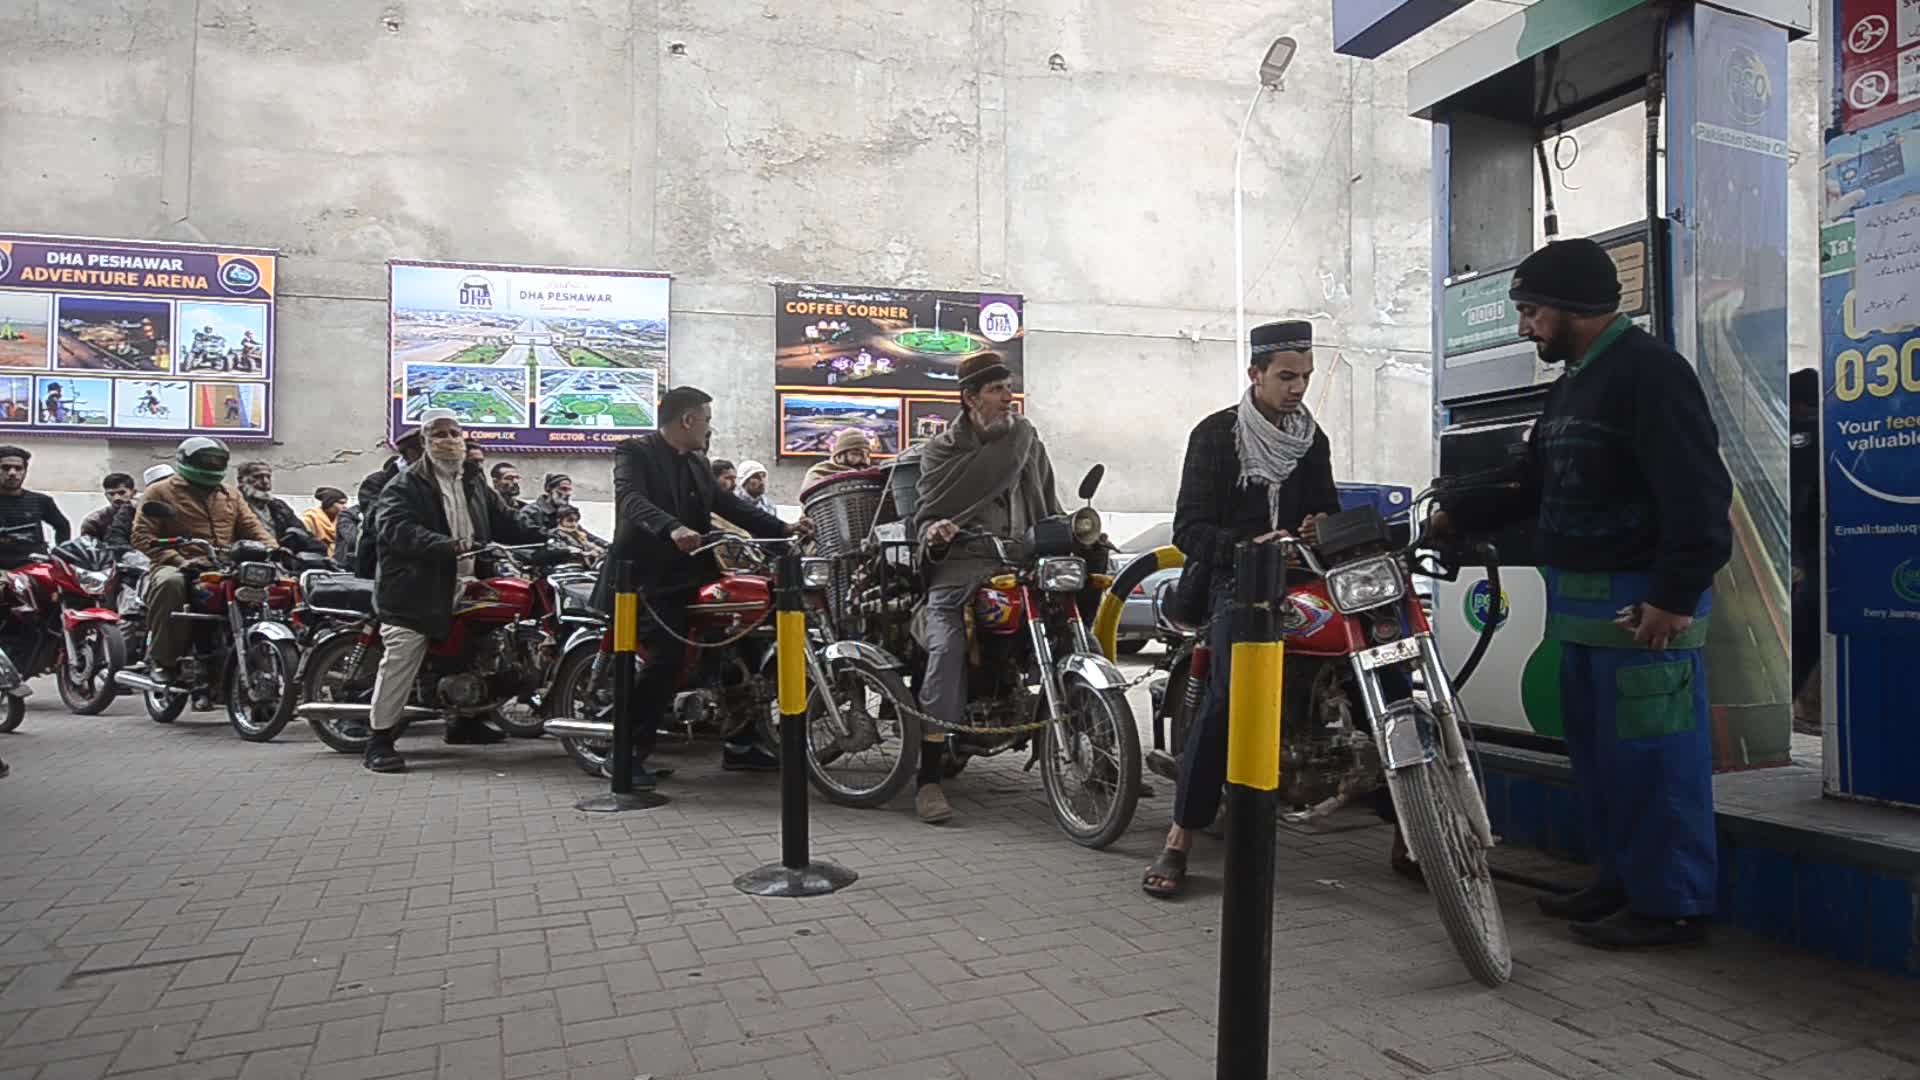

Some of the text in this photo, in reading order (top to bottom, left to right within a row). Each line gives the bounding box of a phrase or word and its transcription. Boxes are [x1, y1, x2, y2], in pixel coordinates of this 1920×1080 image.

[46, 252, 184, 271] DHA PESHAWAR
[20, 267, 209, 289] ADVENTURE ARENA
[519, 290, 613, 304] DHA PESHAWAR
[786, 302, 909, 319] COFFEE CORNER
[1837, 420, 1881, 434] Your
[470, 430, 517, 440] COMPLEX
[549, 432, 586, 442] SECTOR
[593, 433, 600, 442] C
